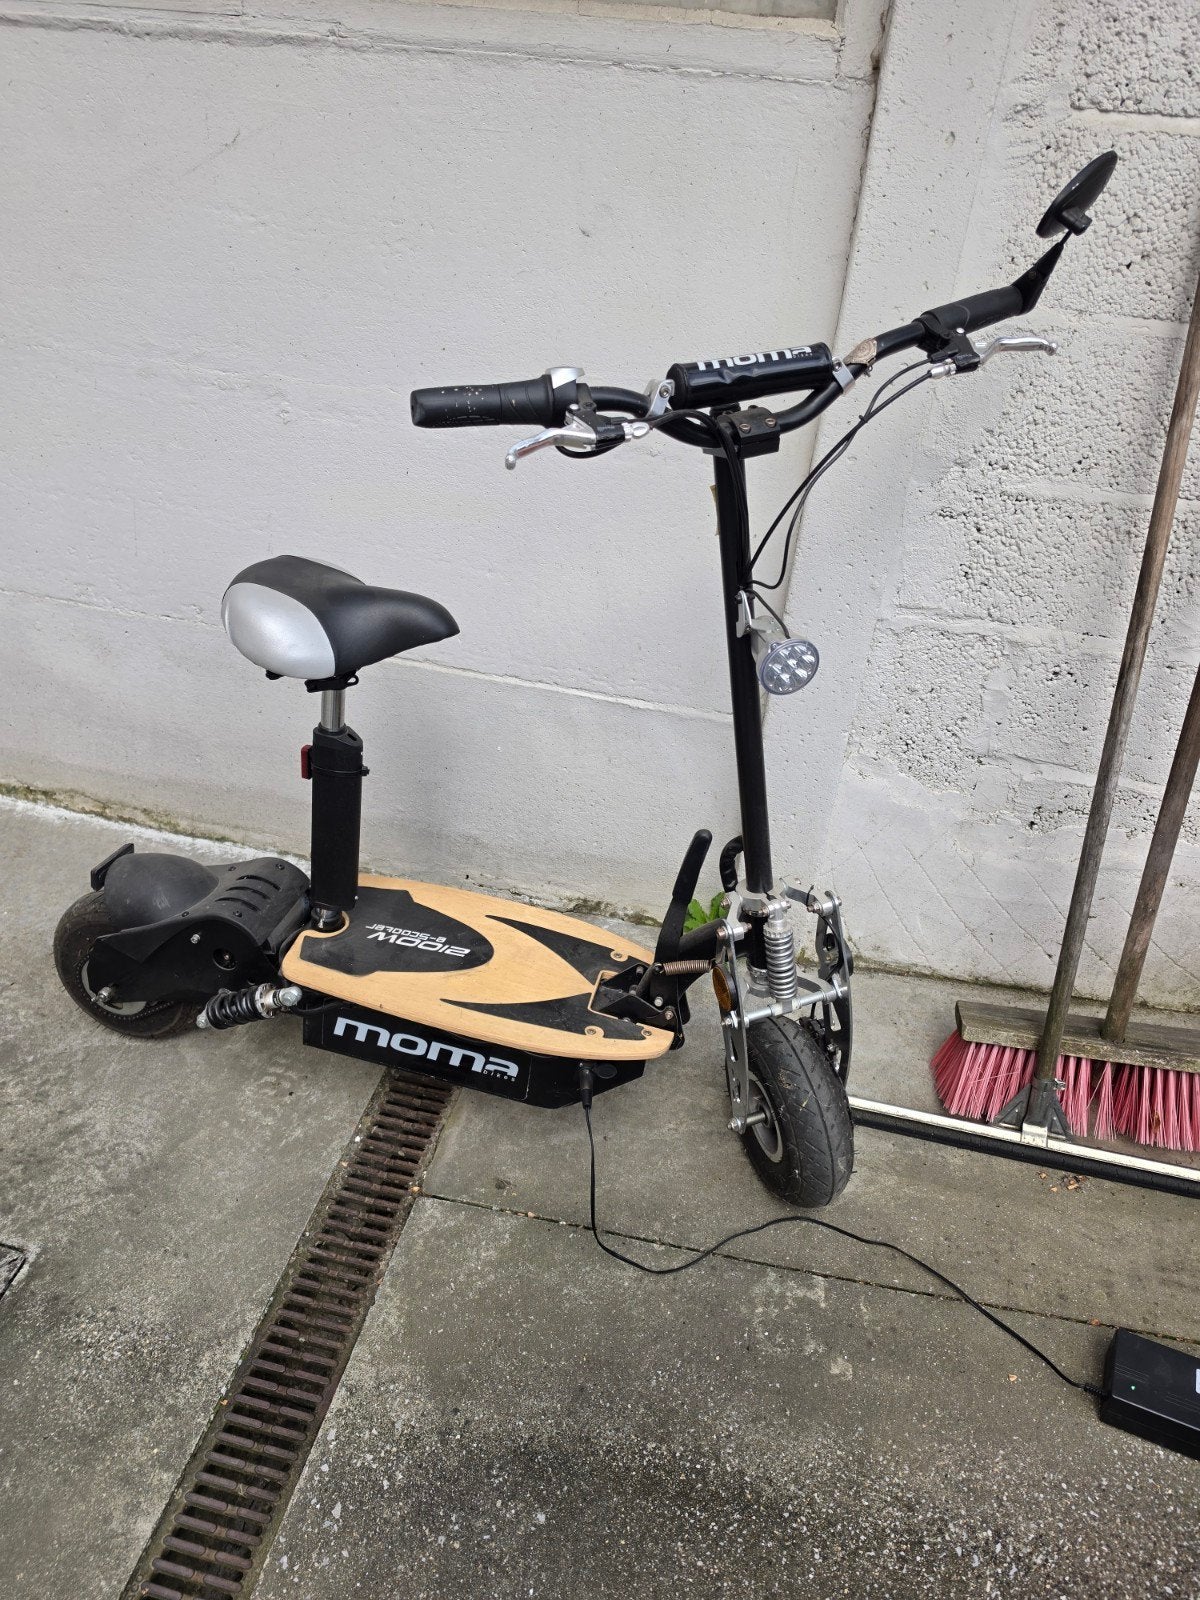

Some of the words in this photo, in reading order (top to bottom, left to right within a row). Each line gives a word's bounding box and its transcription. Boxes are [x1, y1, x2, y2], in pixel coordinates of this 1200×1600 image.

[697, 346, 812, 370] moma
[366, 931, 471, 957] 2100W
[333, 1016, 519, 1077] moma
[483, 1069, 516, 1082] bikes
